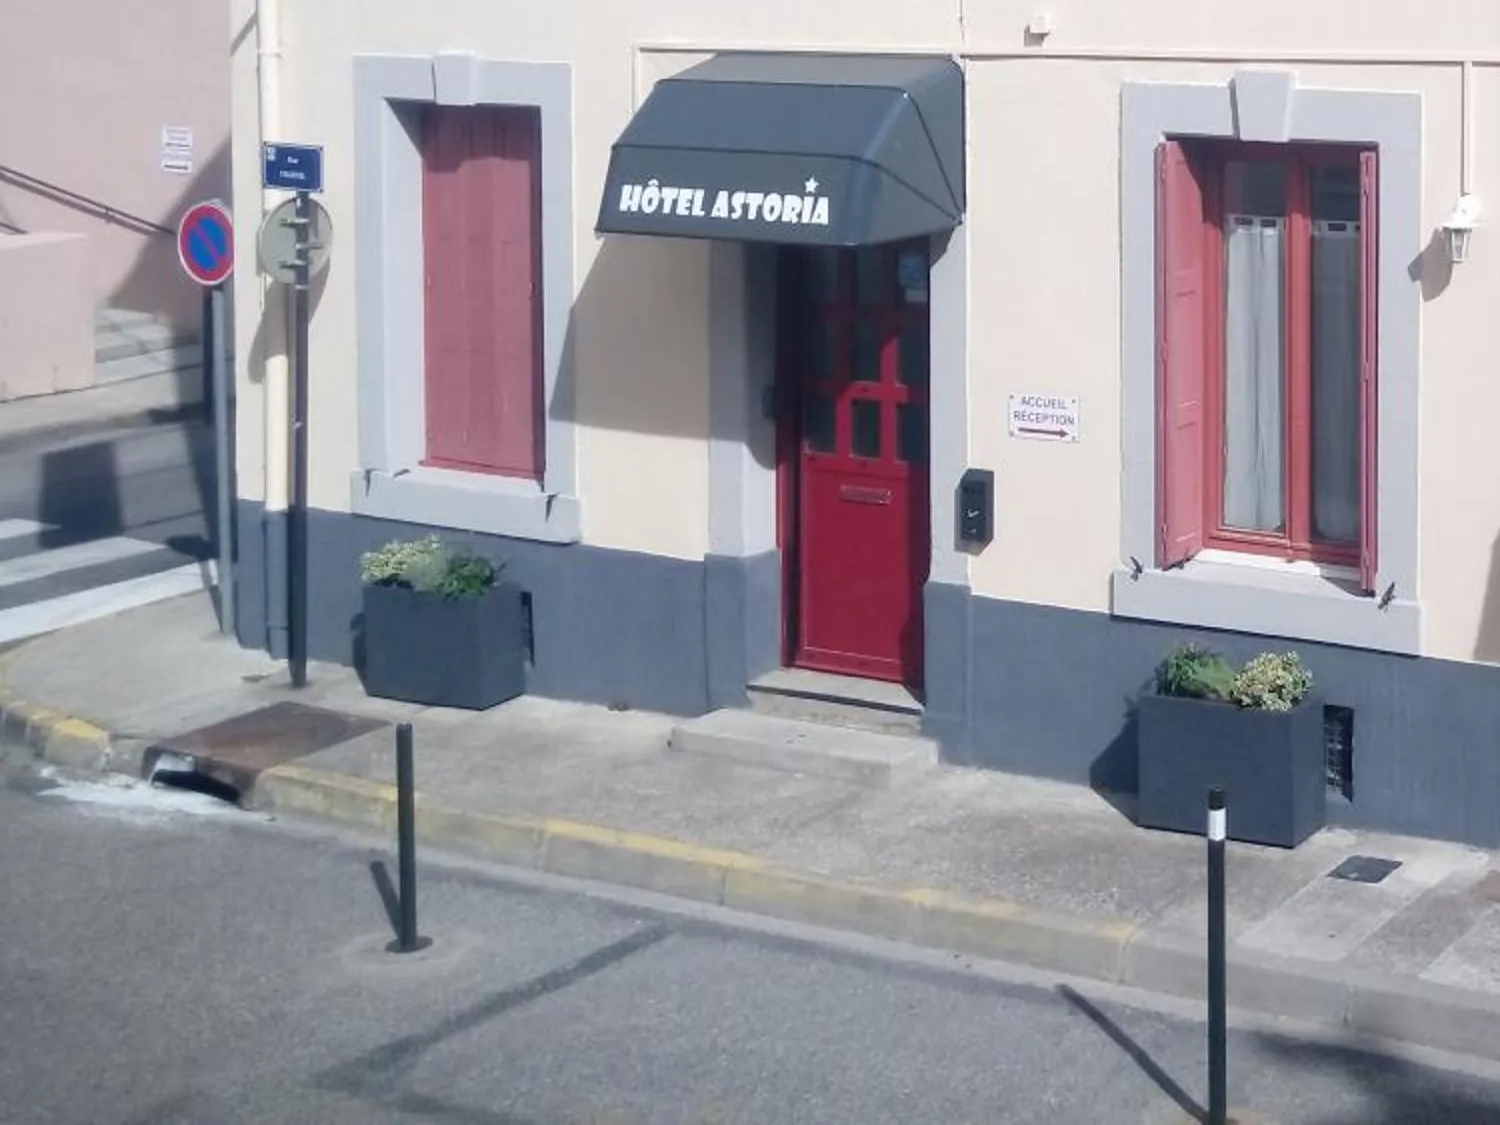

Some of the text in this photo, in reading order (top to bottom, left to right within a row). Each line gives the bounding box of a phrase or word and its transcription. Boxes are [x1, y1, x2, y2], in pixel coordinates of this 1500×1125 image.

[620, 176, 829, 225] HÔTEL ASTORIA
[1021, 396, 1067, 409] ACCUEIL
